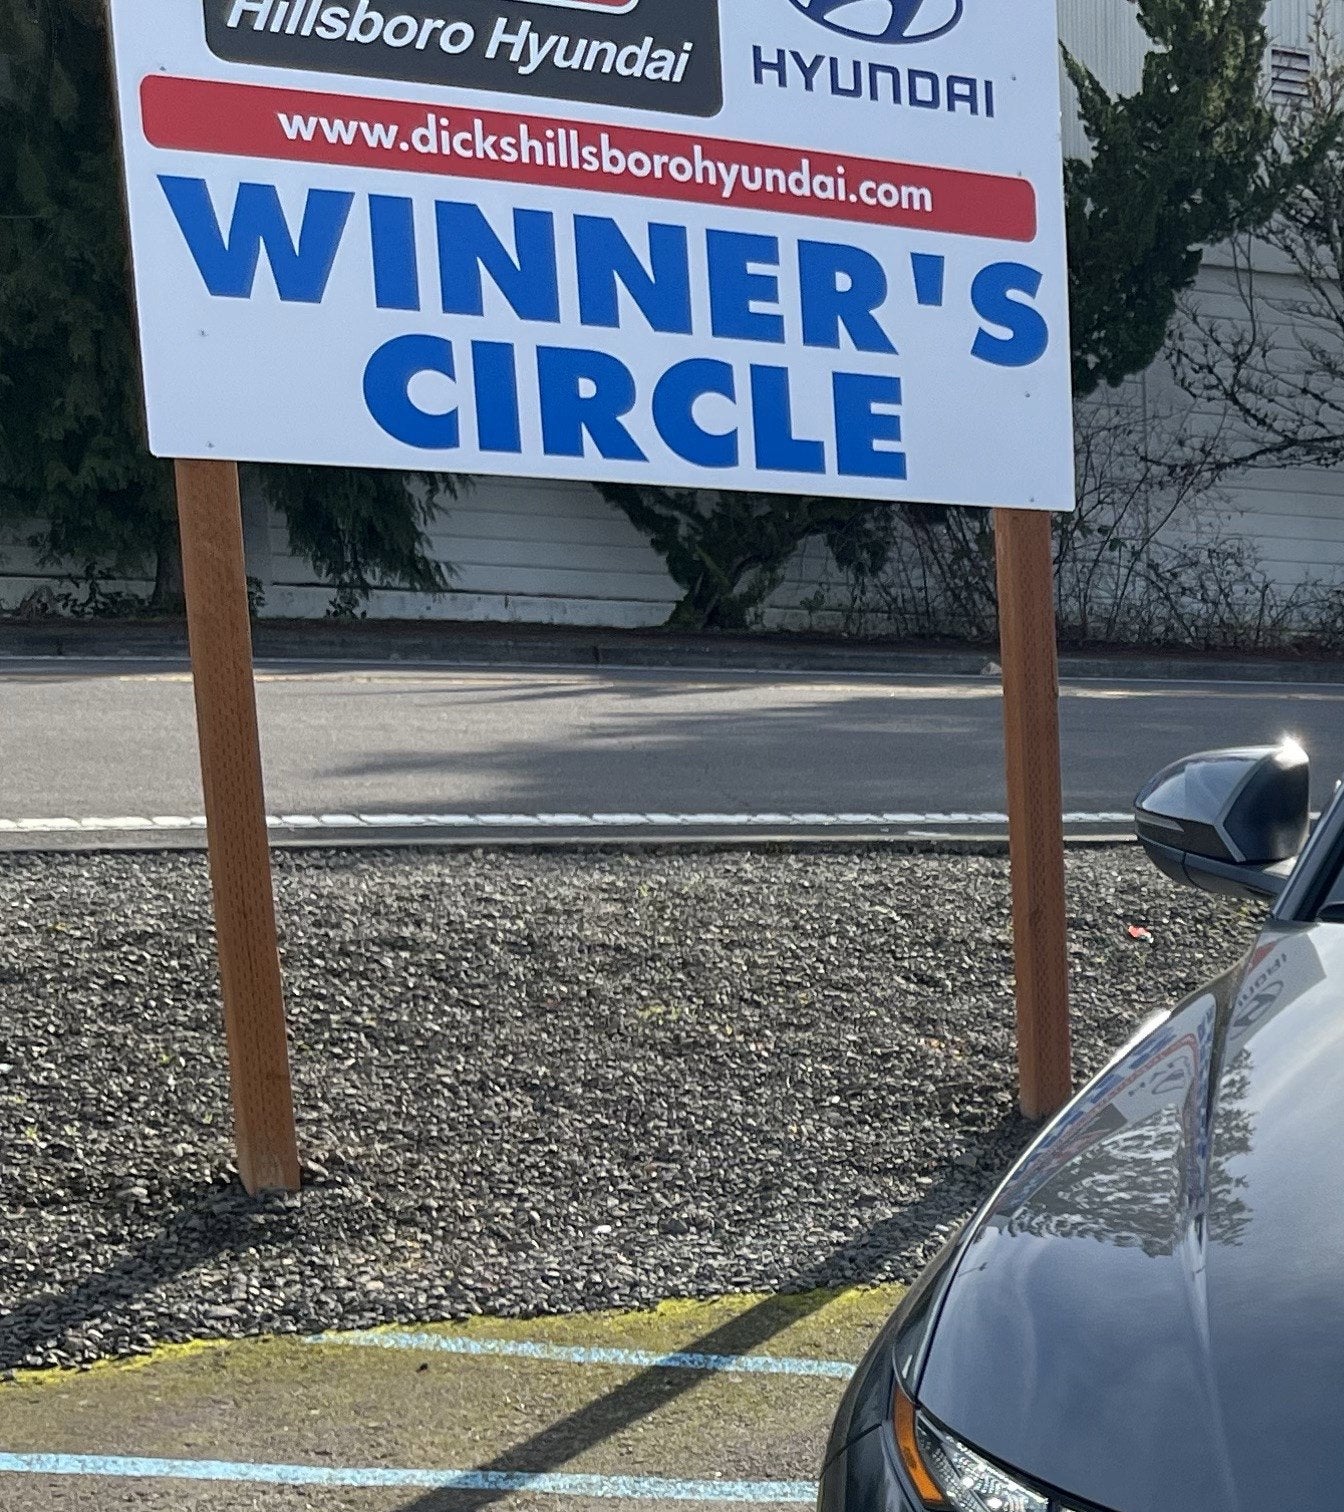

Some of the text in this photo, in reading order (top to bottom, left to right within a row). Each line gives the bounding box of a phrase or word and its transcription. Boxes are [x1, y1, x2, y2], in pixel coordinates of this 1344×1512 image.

[226, 0, 694, 83] Hillsboro Hyundai
[753, 44, 995, 119] HYUNDAI
[277, 109, 934, 214] www.dickshillsborohyundai.com
[156, 173, 1050, 368] WINNER'S
[362, 333, 907, 480] CIRCLE
